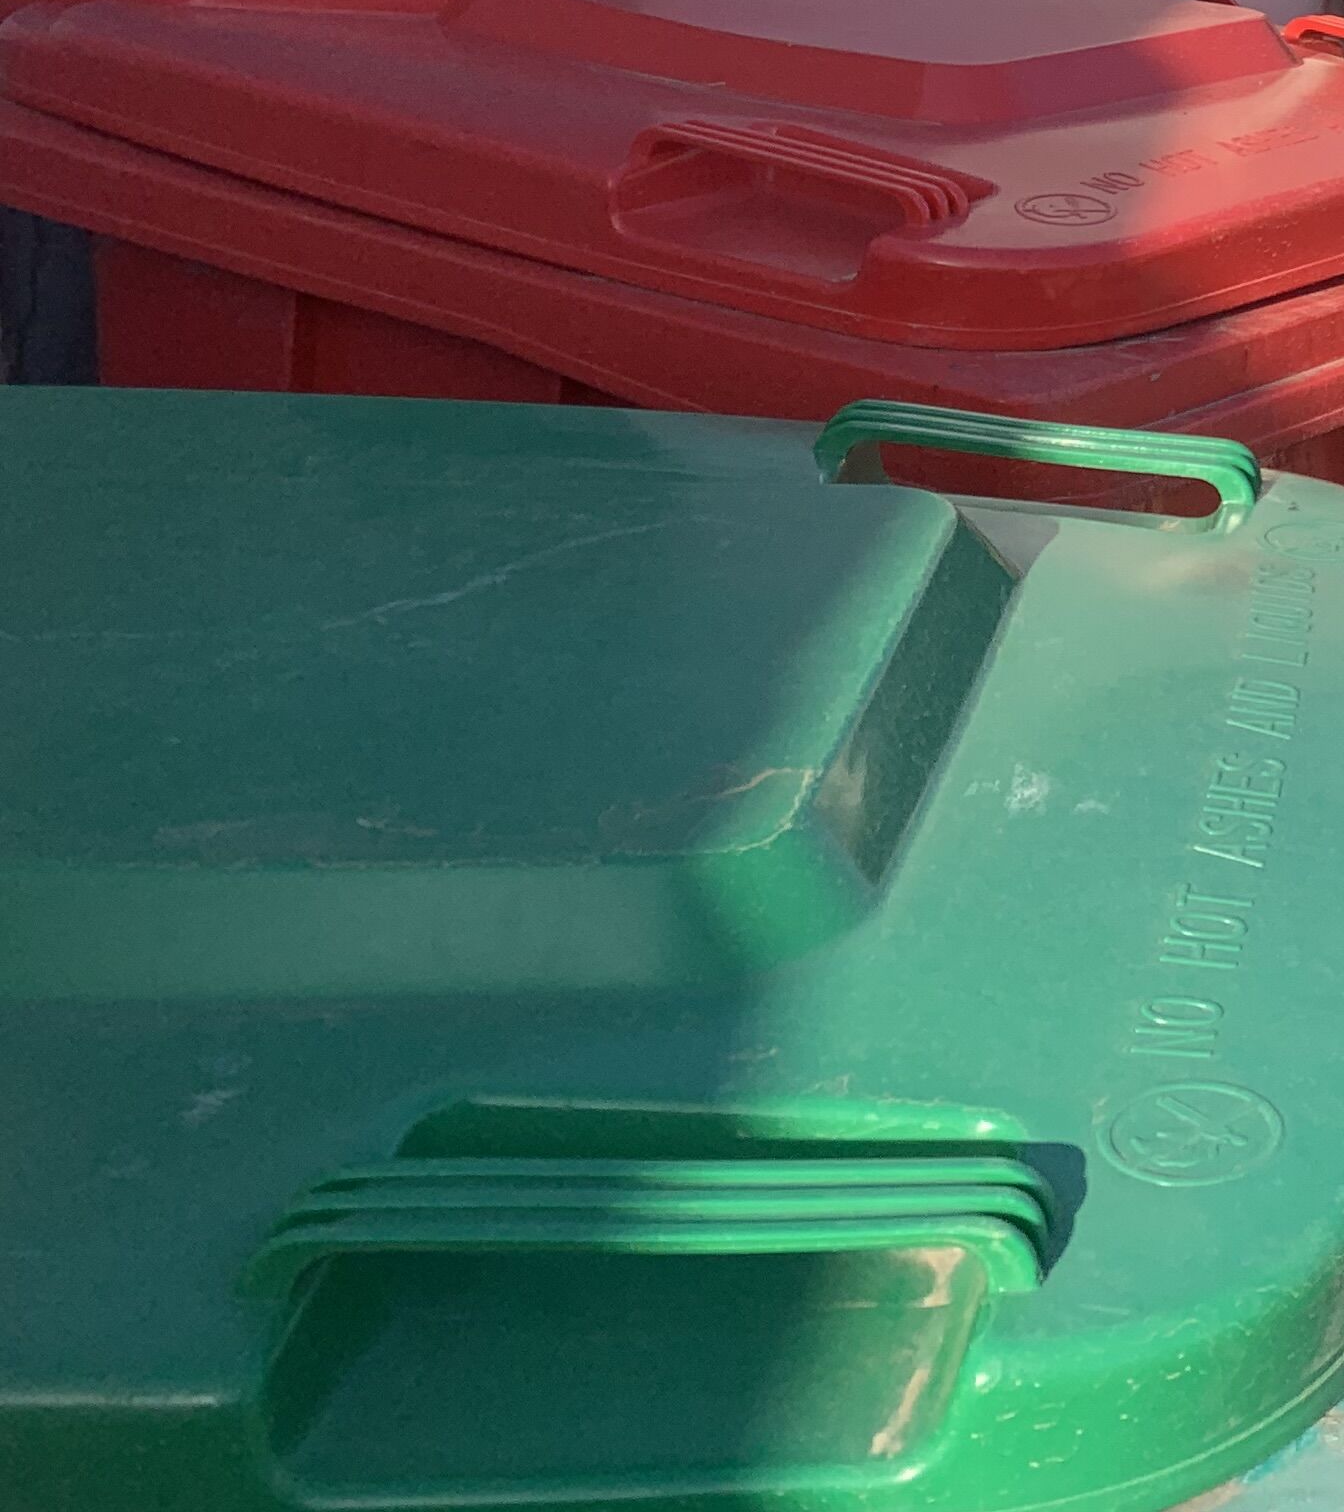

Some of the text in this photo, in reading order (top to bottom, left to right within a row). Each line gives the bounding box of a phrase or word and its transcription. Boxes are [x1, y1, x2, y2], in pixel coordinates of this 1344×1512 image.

[1080, 170, 1145, 195] NO
[1130, 565, 1316, 1058] NO HOT ASHES AND LIQUIDS
